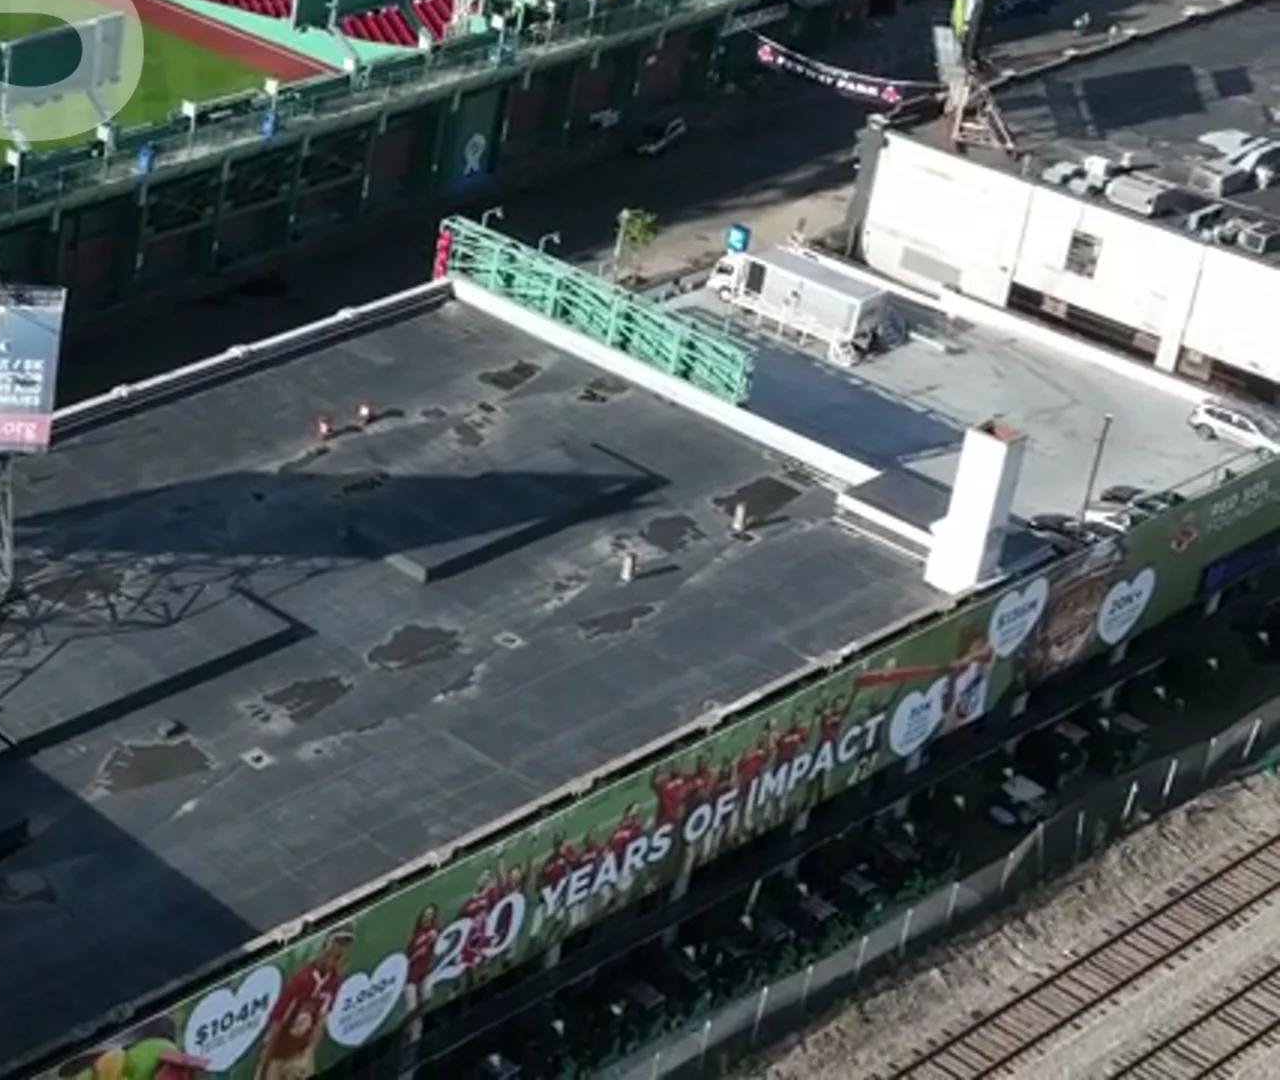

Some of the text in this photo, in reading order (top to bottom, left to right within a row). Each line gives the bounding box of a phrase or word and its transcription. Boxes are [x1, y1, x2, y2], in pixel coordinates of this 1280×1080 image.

[423, 713, 886, 994] 20 YEARS OF IMPACT
[194, 992, 270, 1046] $104M
